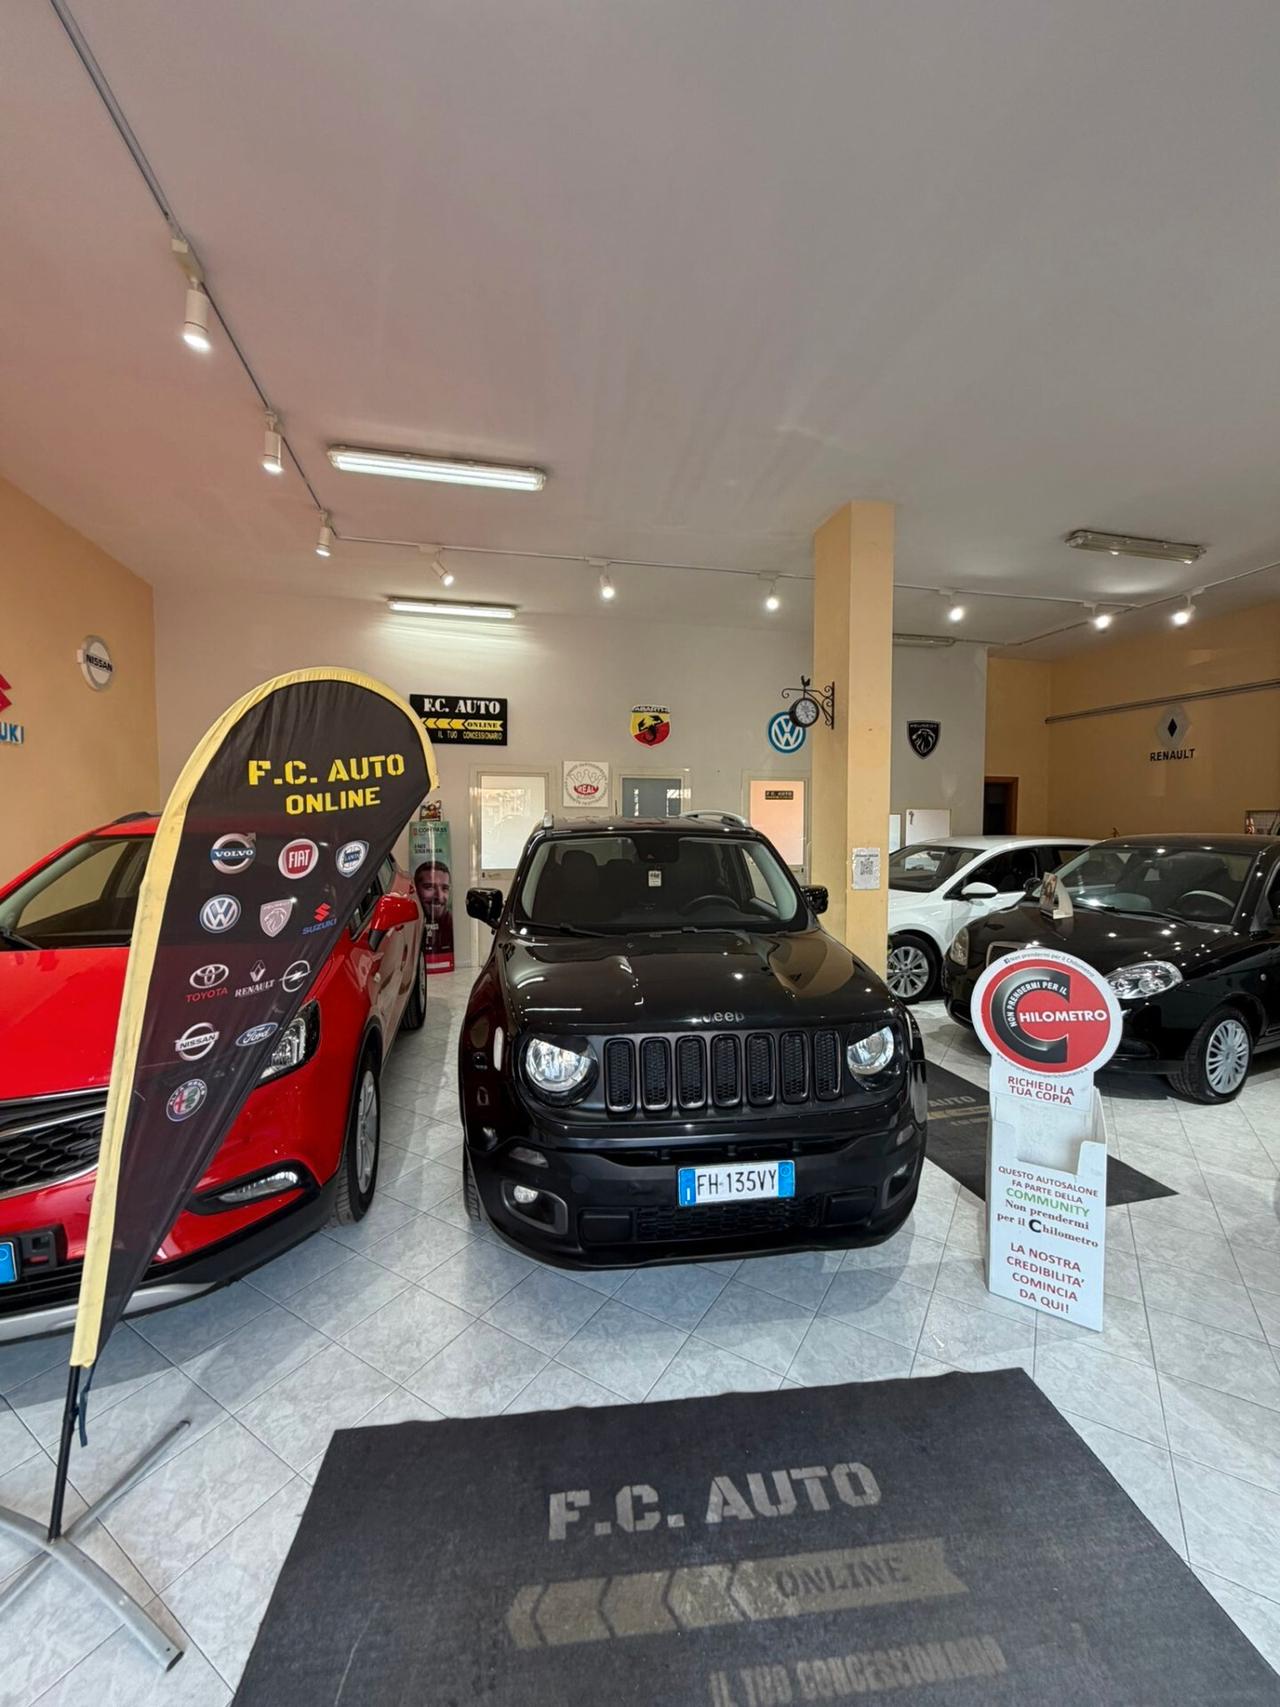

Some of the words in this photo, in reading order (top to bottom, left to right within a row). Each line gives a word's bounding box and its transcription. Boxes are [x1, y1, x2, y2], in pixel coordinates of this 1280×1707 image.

[86, 653, 113, 673] NISSAN
[423, 698, 449, 713] F.C.
[455, 699, 500, 715] AUTO
[0, 721, 24, 745] UKI
[447, 731, 457, 739] TUO
[467, 721, 499, 729] ONLINE
[1150, 748, 1196, 762] RENAULT
[249, 760, 318, 786] F.C.
[328, 754, 405, 782] AUTO
[286, 787, 381, 816] ONLINE
[215, 849, 254, 858] VOLVO
[289, 848, 311, 866] FIAT
[302, 918, 337, 936] SUZUKI
[186, 987, 228, 1003] TOYOTA
[235, 980, 275, 997] RENAULT
[1007, 982, 1041, 1011] PRENDERMI
[1042, 981, 1058, 992] PER
[1060, 987, 1068, 996] IL
[703, 1011, 745, 1023] Jeep
[1006, 1013, 1017, 1028] NON
[180, 1033, 217, 1049] NISSAN
[243, 1027, 271, 1043] Ford
[1008, 1075, 1057, 1093] RICHIEDI
[1060, 1086, 1075, 1097] LA
[1009, 1085, 1033, 1098] TUA
[1035, 1091, 1072, 1106] COPIA
[998, 1165, 1034, 1181] QUESTO
[1036, 1175, 1099, 1197] AUTOSALONE
[1012, 1179, 1022, 1188] FA
[1024, 1182, 1052, 1196] PARTE
[1054, 1191, 1083, 1204] DELLA
[1006, 1187, 1090, 1218] COMMUNITY
[1005, 1199, 1026, 1213] Non
[1030, 1207, 1089, 1230] prendermi
[997, 1213, 1015, 1224] per
[1017, 1215, 1025, 1227] il
[1028, 1219, 1099, 1248] Chilometro
[1010, 1242, 1025, 1255] LA
[1029, 1248, 1081, 1273] NOSTRA
[1006, 1256, 1085, 1288] CREDIBILITA'
[1012, 1272, 1078, 1301] COMINCIA
[1019, 1288, 1037, 1301] DA
[1040, 1296, 1069, 1314] QUI!
[548, 1484, 685, 1541] F.C.
[705, 1462, 883, 1524] AUTO
[775, 1557, 910, 1600] ONLINE
[740, 1664, 792, 1706] TUO
